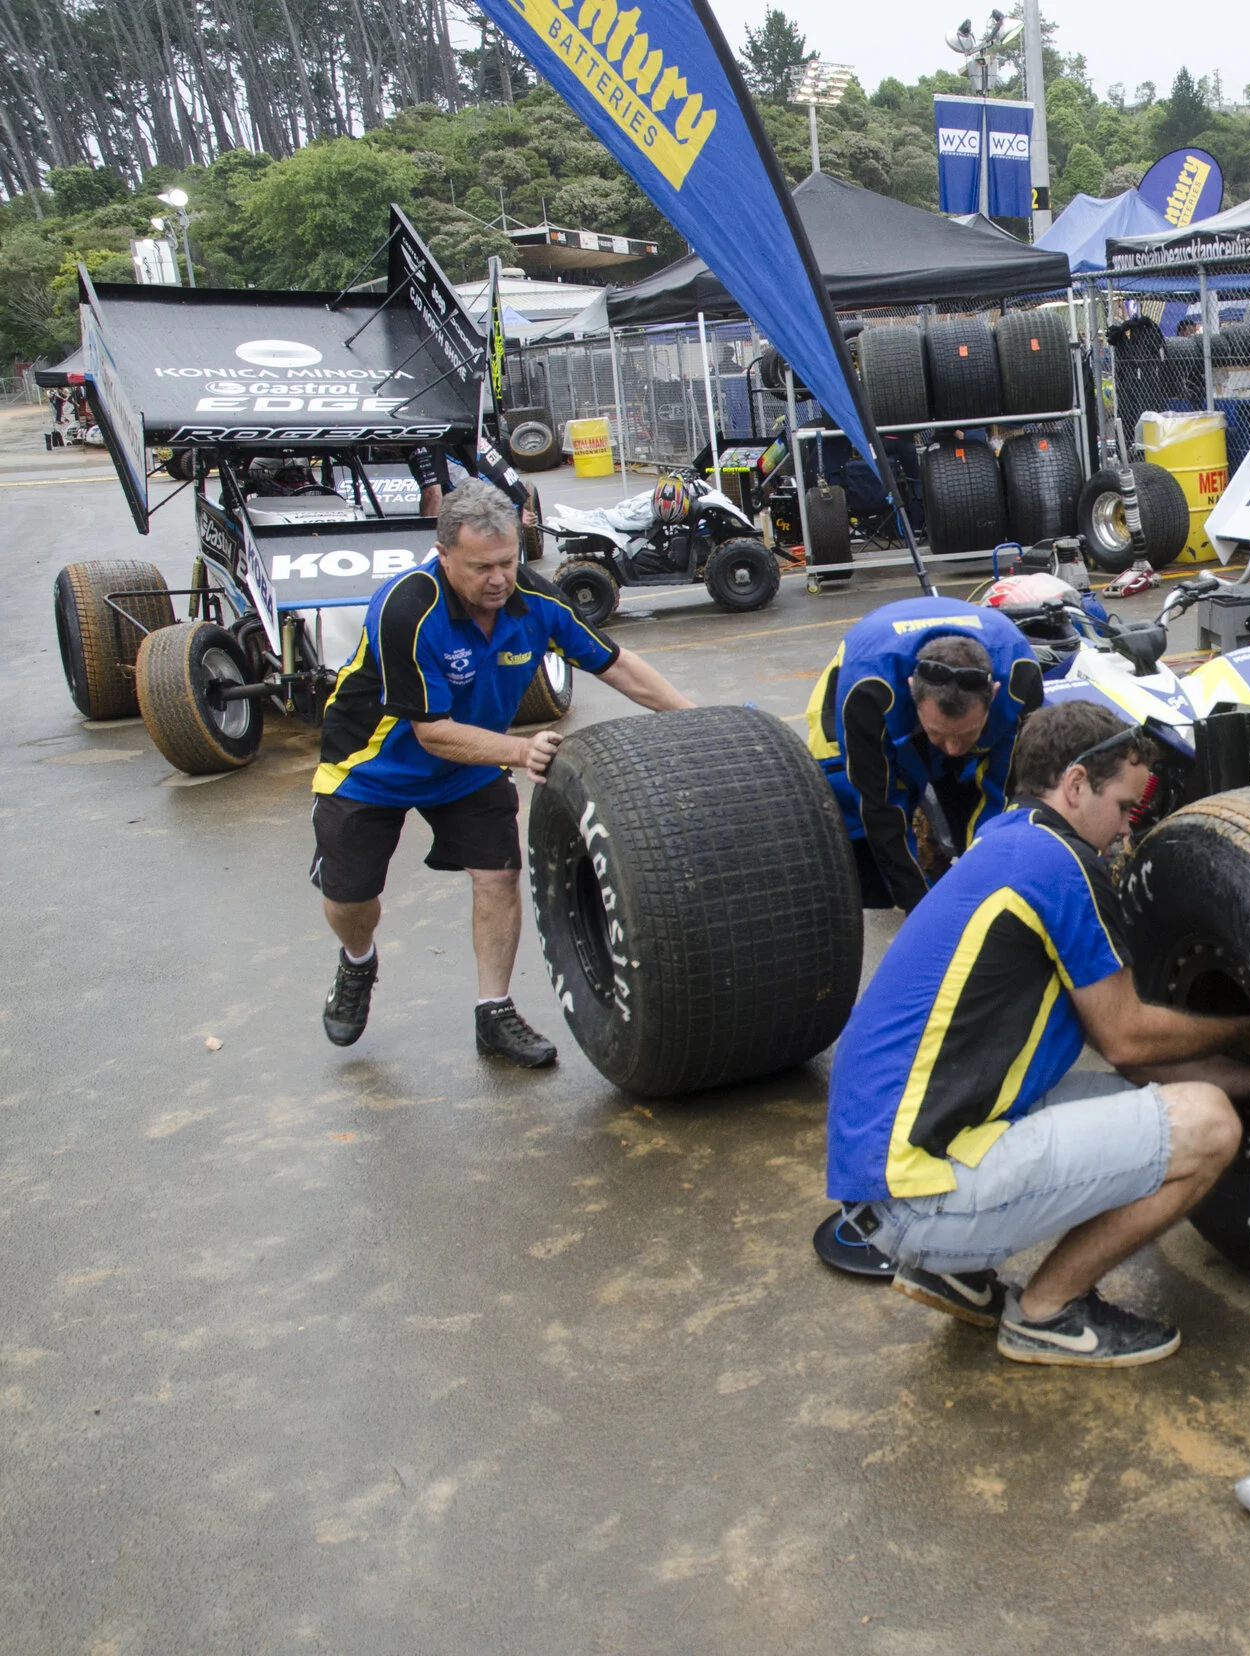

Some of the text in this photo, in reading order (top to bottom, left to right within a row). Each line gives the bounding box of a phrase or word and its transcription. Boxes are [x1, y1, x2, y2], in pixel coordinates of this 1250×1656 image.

[548, 17, 658, 147] BATTERIES
[942, 130, 977, 152] WXC
[992, 133, 1027, 156] WXC
[154, 367, 416, 380] KONICA MINOLTA
[248, 381, 361, 396] Castrol
[194, 396, 411, 413] EDGE
[168, 424, 452, 443] ROGERS
